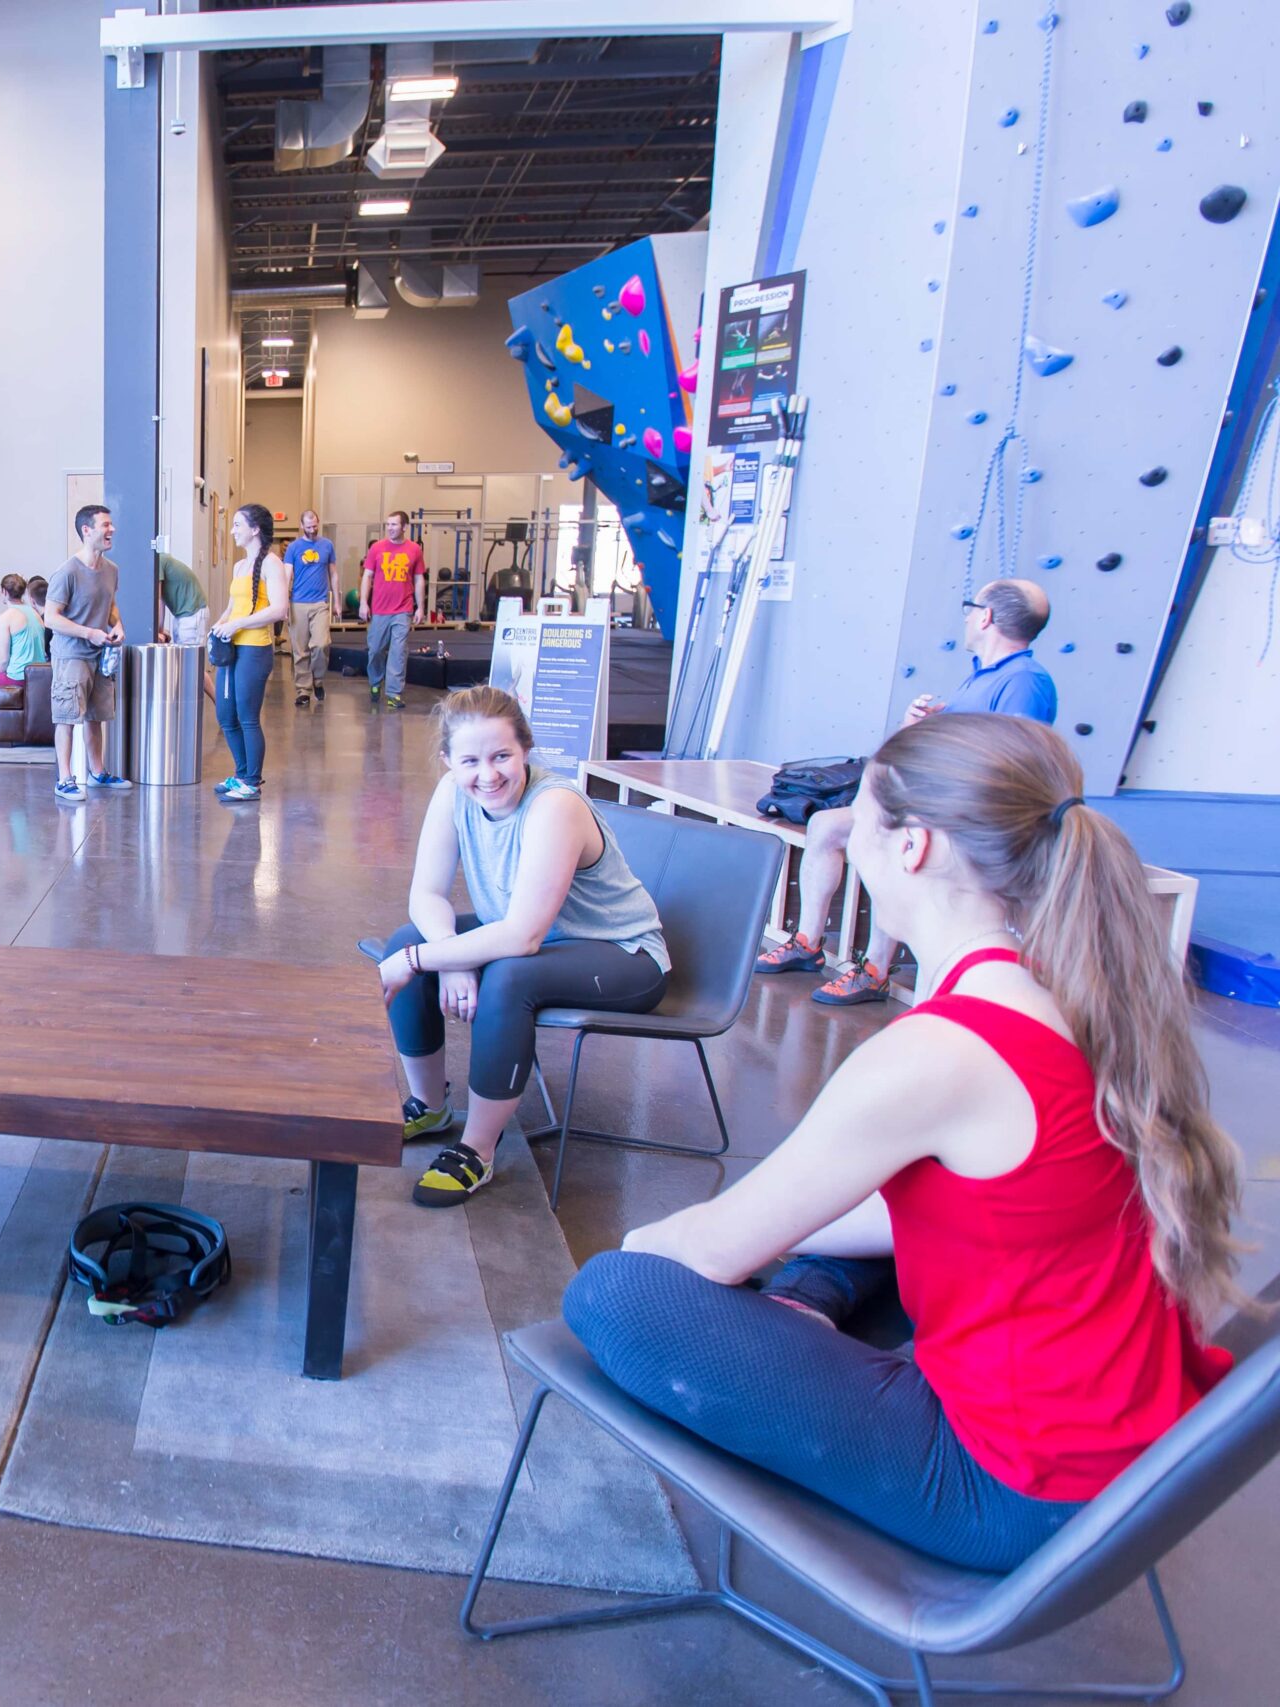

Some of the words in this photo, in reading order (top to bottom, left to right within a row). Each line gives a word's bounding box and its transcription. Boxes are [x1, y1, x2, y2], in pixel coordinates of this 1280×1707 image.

[733, 290, 789, 307] PROGRESSION
[542, 627, 584, 639] BOULDERING
[584, 629, 593, 639] IS
[541, 638, 582, 649] DANGEROUS
